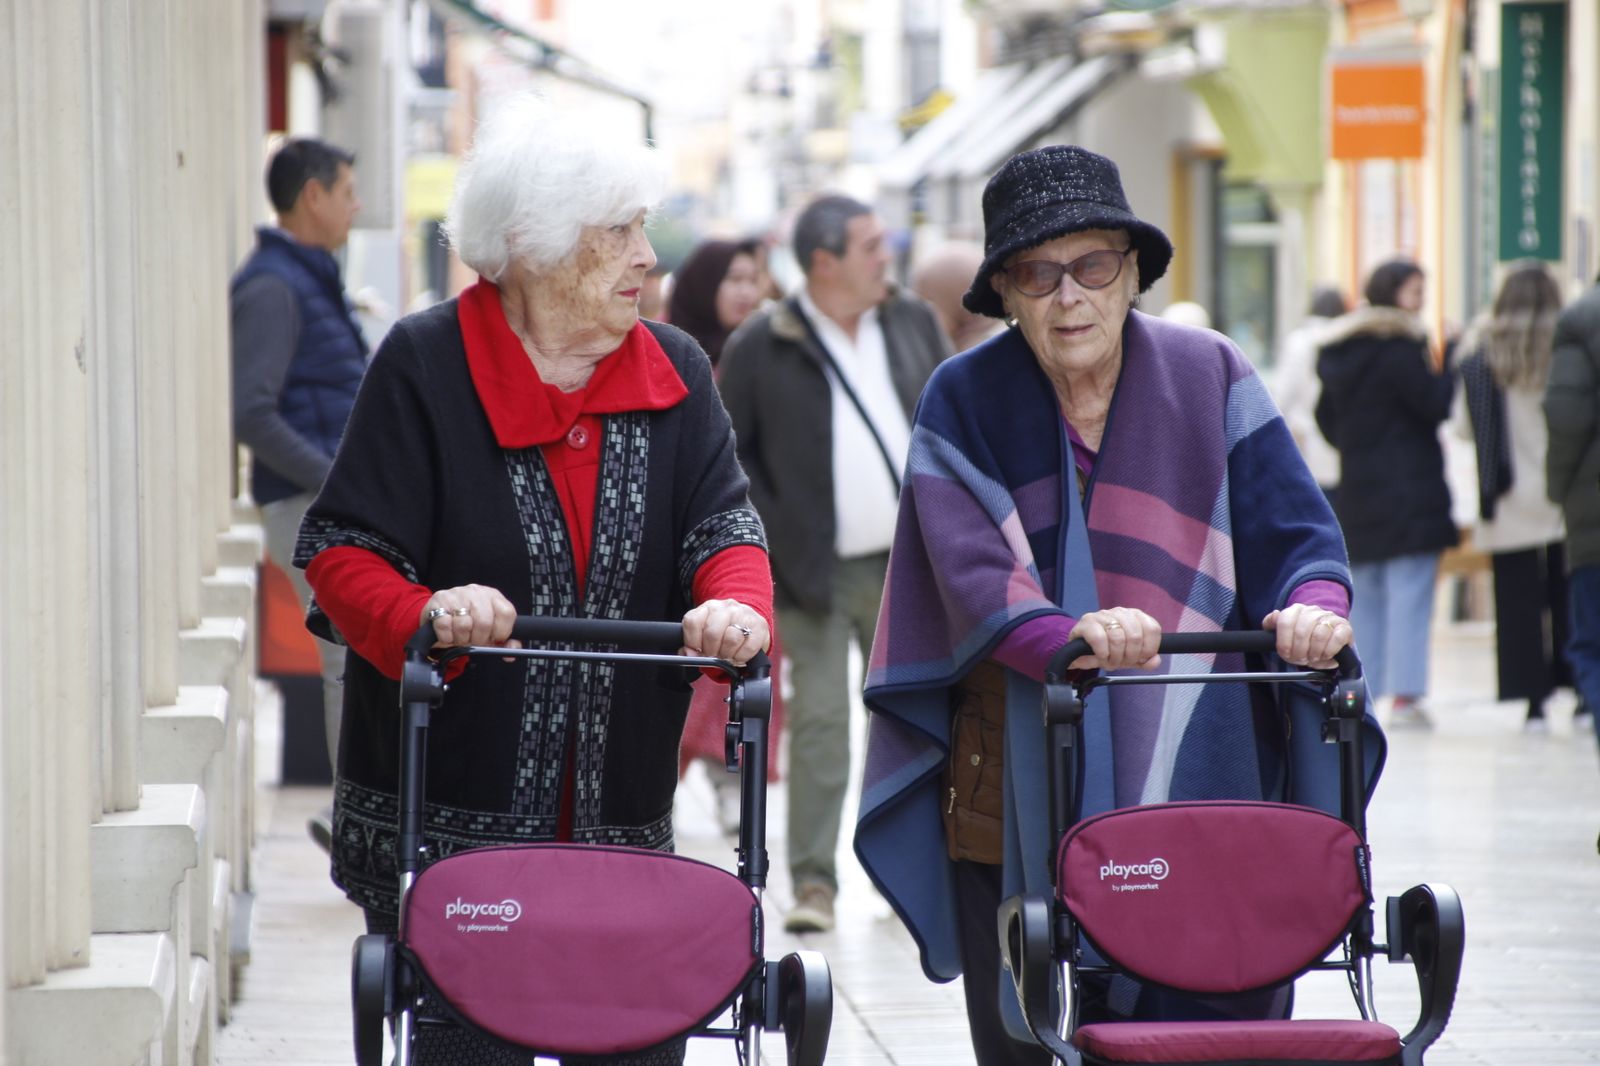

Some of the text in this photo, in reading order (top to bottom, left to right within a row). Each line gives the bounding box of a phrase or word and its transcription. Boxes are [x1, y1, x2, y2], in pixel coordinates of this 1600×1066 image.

[1100, 858, 1169, 880] playcare
[1121, 883, 1159, 892] playmarket
[446, 897, 521, 921] playcare
[457, 923, 508, 932] by playmarket
